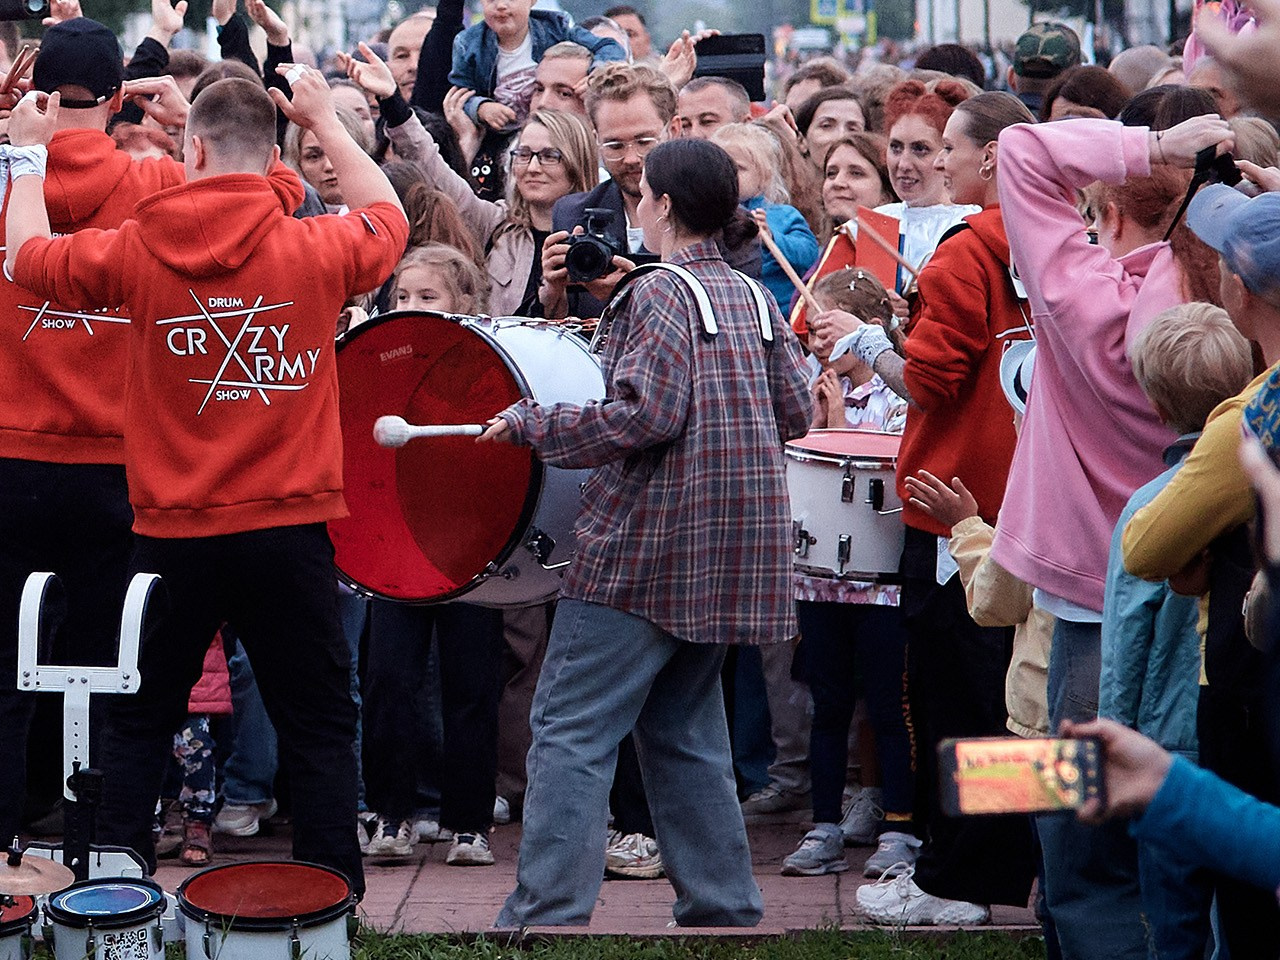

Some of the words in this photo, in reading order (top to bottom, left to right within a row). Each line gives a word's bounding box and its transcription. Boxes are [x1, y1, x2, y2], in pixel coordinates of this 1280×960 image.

[208, 297, 244, 308] DRUM
[41, 319, 76, 329] SHOW
[380, 344, 413, 361] EVANS
[216, 390, 251, 401] SHOW
